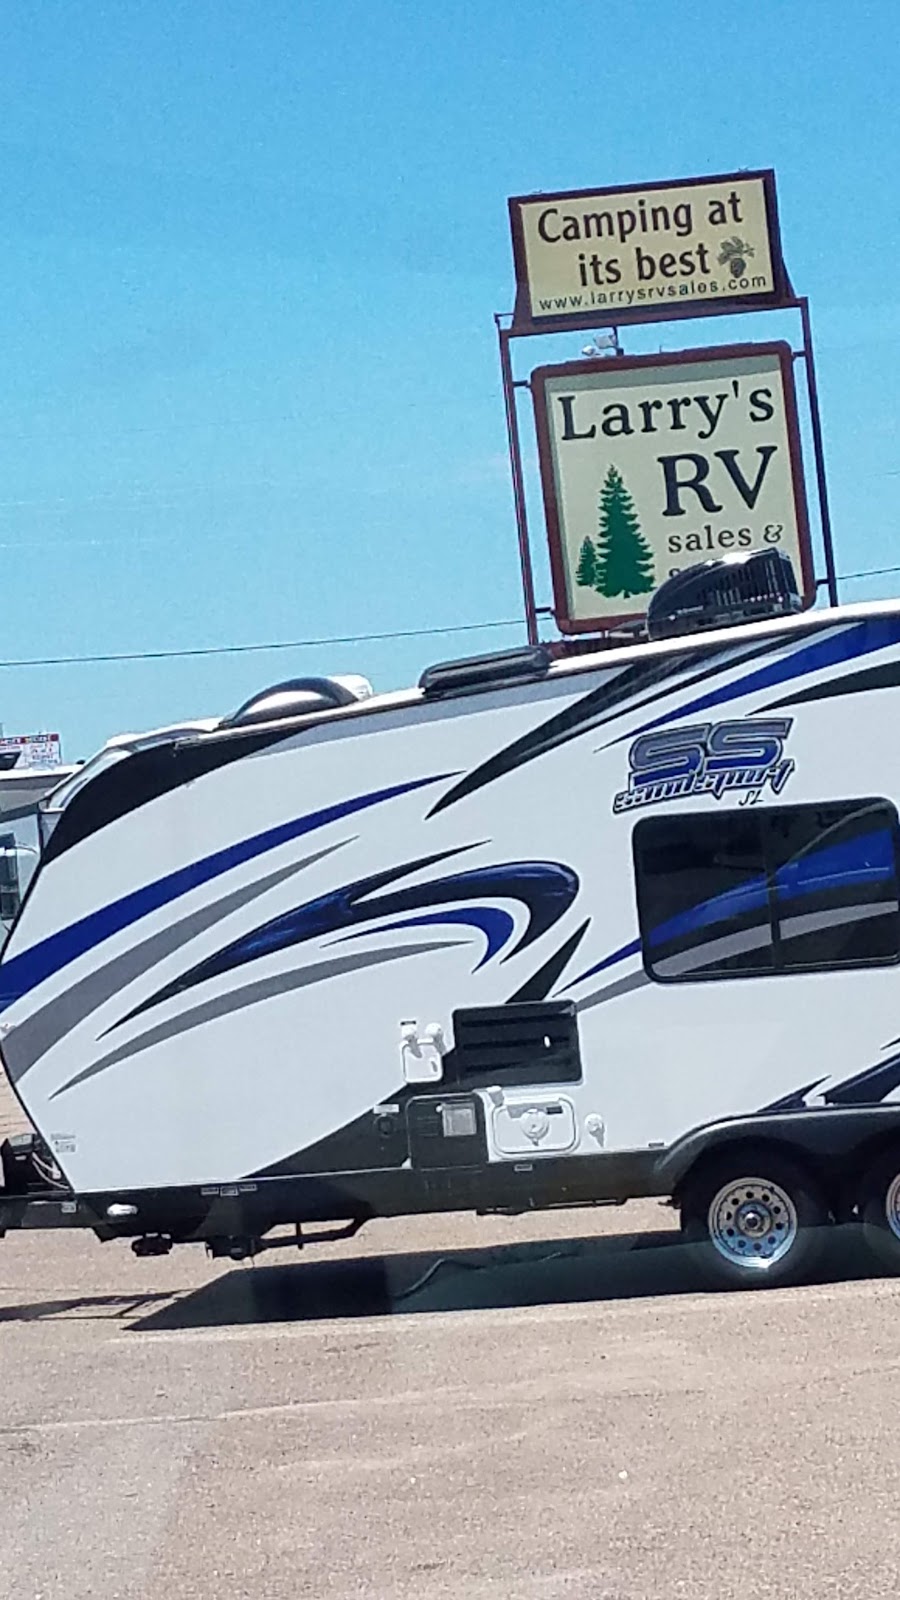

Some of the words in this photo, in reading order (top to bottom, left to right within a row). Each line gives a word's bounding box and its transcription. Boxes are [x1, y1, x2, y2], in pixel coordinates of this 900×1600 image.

[538, 199, 693, 243] Camping
[708, 191, 743, 225] at
[578, 253, 622, 286] its
[635, 243, 711, 280] best
[539, 274, 767, 310] www.larrysrvsales.com
[557, 380, 775, 441] Larry's
[657, 445, 778, 516] RV
[668, 525, 752, 554] sales
[762, 524, 784, 543] &
